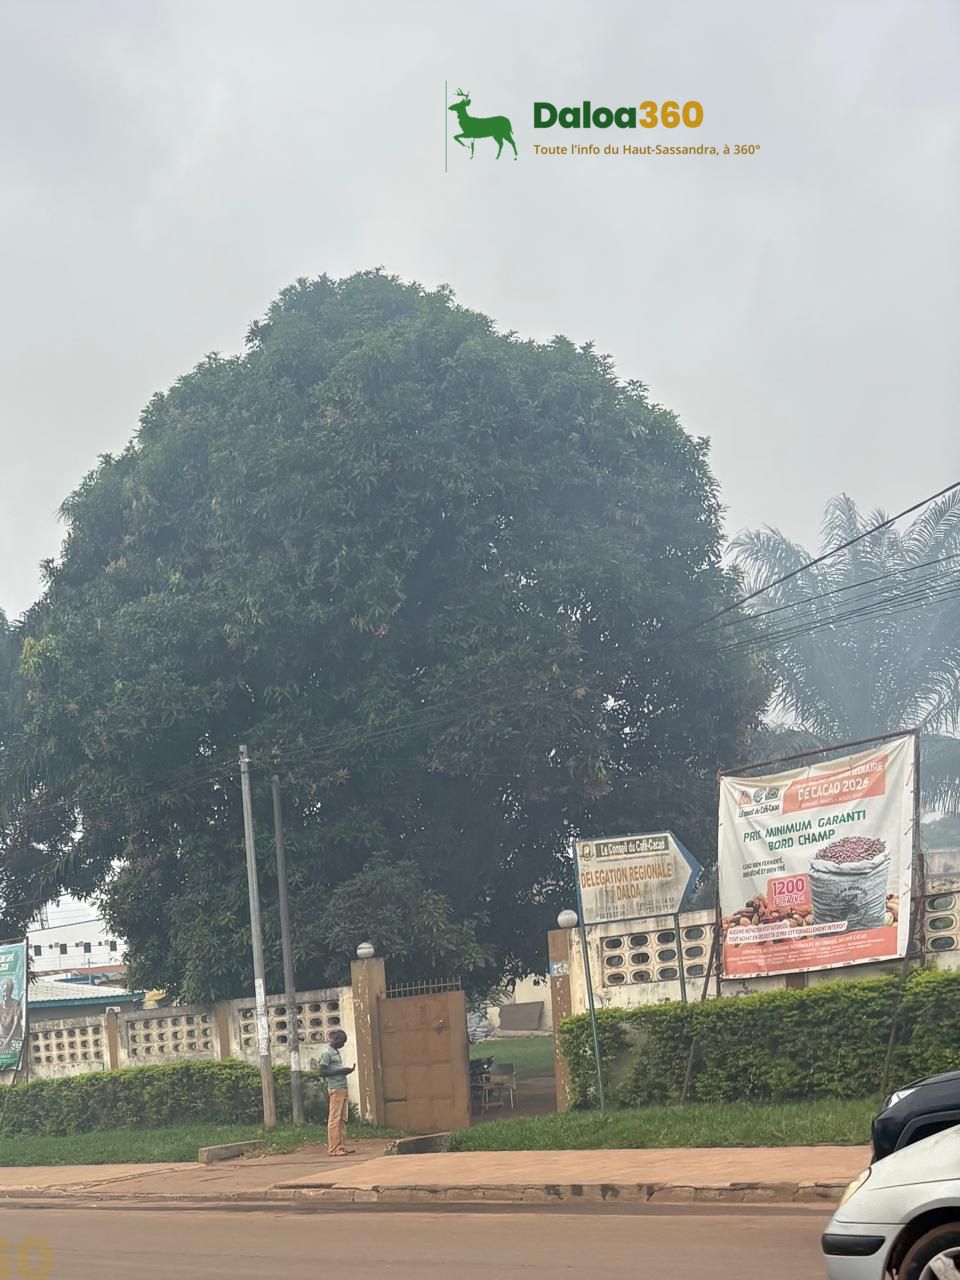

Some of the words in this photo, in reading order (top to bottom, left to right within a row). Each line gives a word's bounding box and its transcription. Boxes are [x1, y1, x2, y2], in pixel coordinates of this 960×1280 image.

[798, 786, 810, 800] DE
[811, 782, 840, 798] CACAO
[842, 777, 869, 792] 2026
[765, 819, 812, 838] MINIMUM
[817, 809, 866, 827] GARANTI
[628, 841, 636, 854] du
[767, 838, 794, 851] BORD
[798, 829, 836, 846] CHAMP
[580, 866, 627, 889] DELEGATION
[629, 862, 673, 883] REGIONALE
[616, 883, 641, 901] DALOA
[772, 877, 805, 897] 1200
